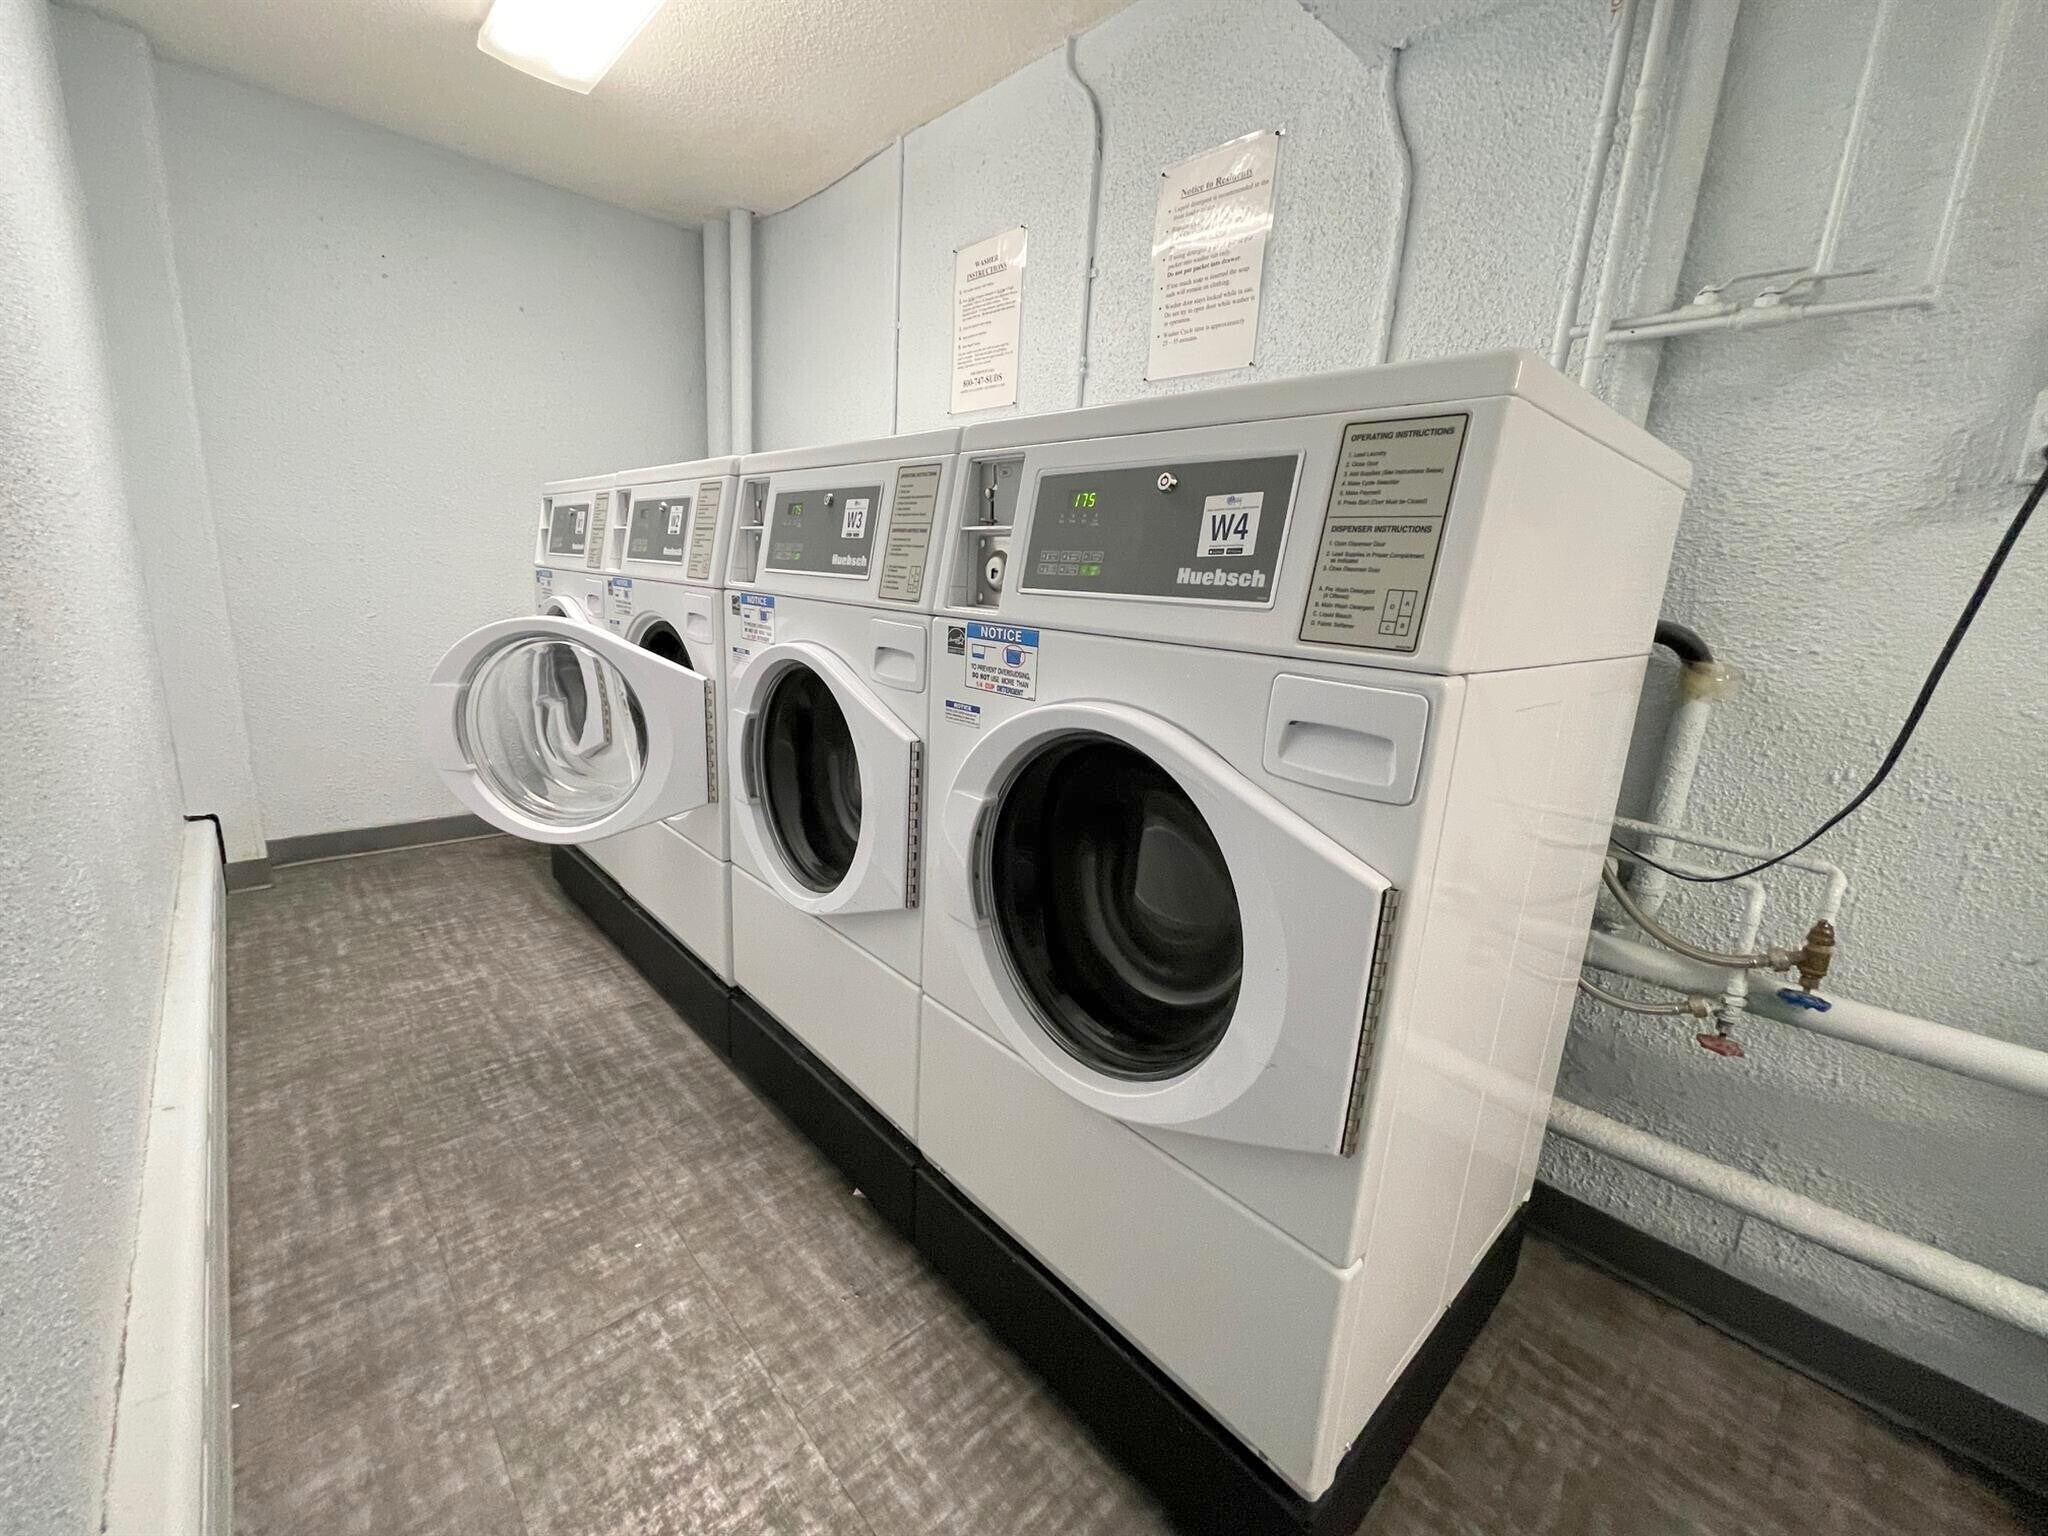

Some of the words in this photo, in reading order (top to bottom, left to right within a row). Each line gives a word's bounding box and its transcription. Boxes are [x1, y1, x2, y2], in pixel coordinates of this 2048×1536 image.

[1182, 185, 1204, 197] Notice
[1216, 169, 1253, 186] Residents
[975, 254, 998, 267] WASHER
[1193, 263, 1209, 273] packet
[967, 263, 1008, 282] INSTRUCTIONS
[1351, 431, 1393, 442] OPERATING
[1395, 427, 1455, 439] INSTRUCTIONS
[1074, 492, 1096, 507] 175
[847, 511, 863, 528] W3
[1212, 513, 1248, 541] W4
[832, 554, 867, 566] Huebsch
[1176, 567, 1266, 588] Huebsch
[980, 626, 1022, 642] NOTICE
[977, 665, 997, 674] PREVENT
[1001, 677, 1015, 685] MORE
[1016, 680, 1029, 688] THAN
[996, 685, 1024, 696] DETERGENT
